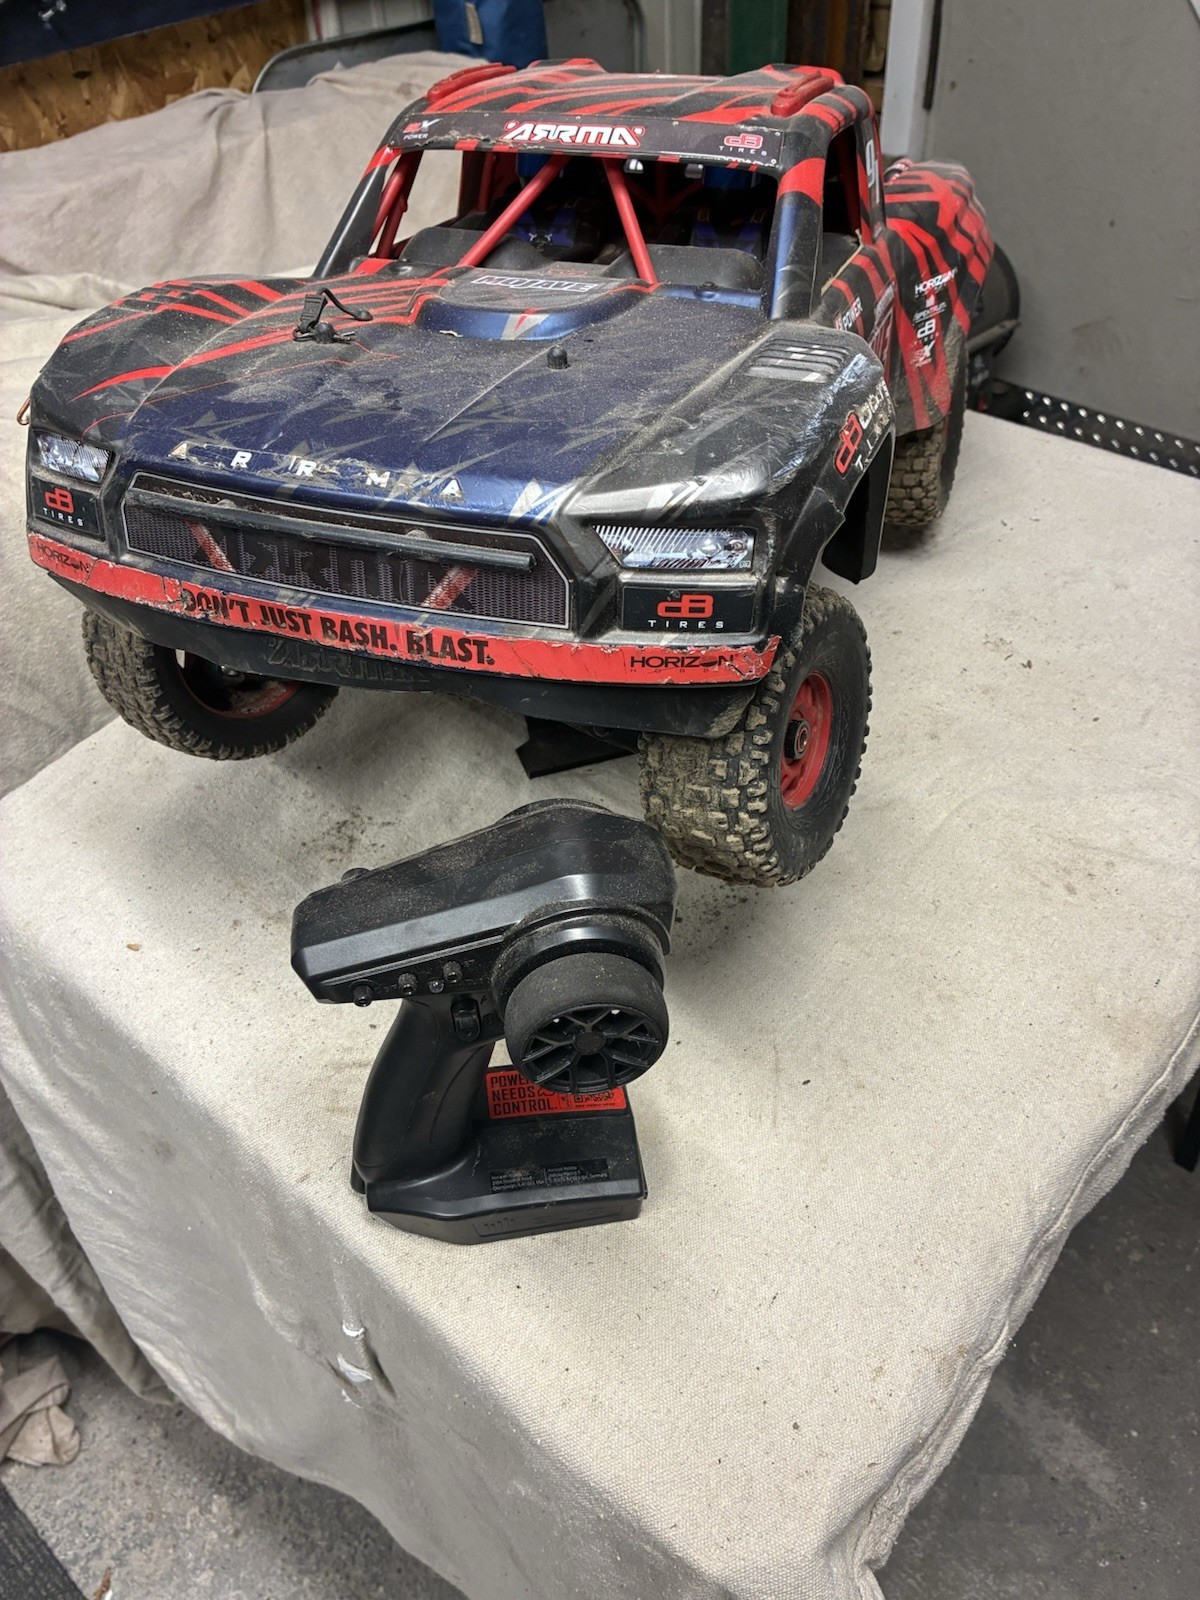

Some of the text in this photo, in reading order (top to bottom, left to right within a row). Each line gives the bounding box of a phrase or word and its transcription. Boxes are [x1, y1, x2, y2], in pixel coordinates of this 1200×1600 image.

[501, 121, 644, 146] ARRMA
[719, 145, 767, 157] TIRES
[470, 275, 599, 293] MOJAVE
[43, 507, 84, 527] TIRES
[184, 590, 495, 666] DON'T JUST BASH. BLAST.
[648, 620, 725, 629] TIRES
[630, 655, 734, 668] HORIZON
[491, 1085, 535, 1102] NEEDS
